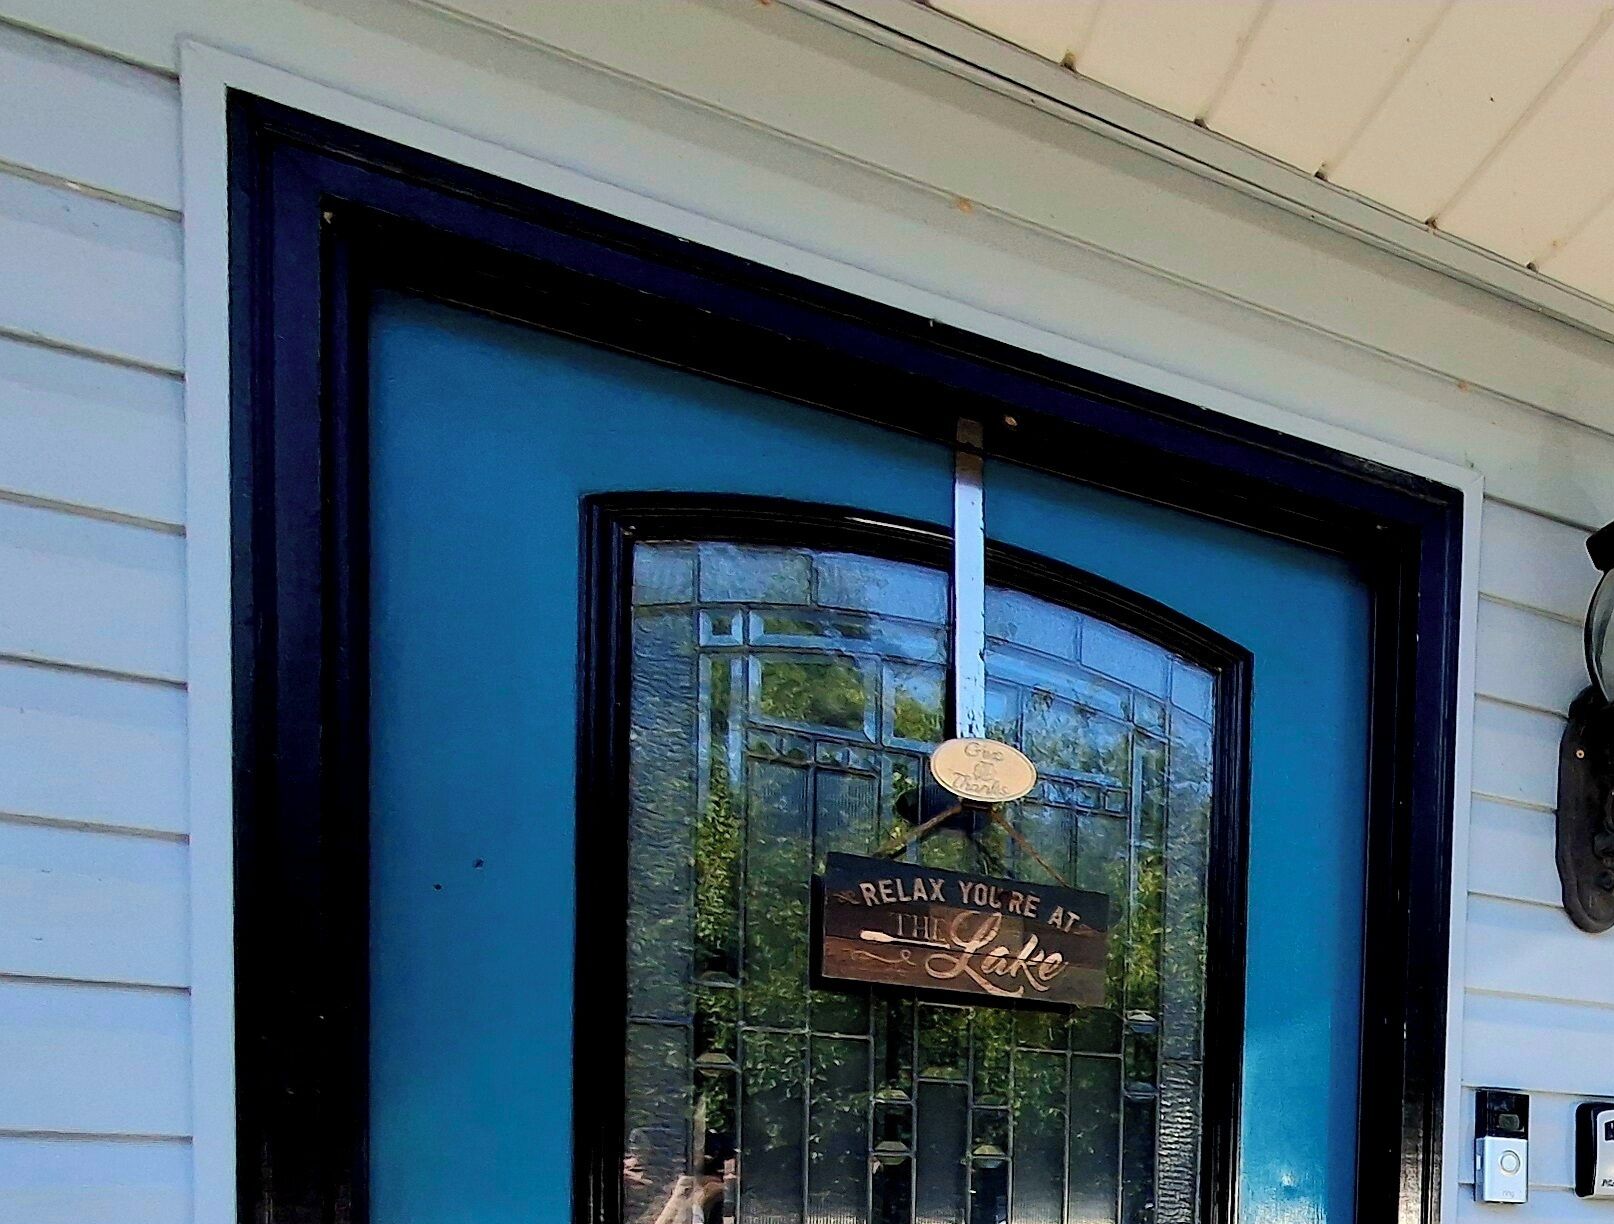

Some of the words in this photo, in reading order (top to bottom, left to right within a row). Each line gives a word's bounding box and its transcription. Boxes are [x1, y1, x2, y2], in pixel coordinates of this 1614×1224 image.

[859, 877, 946, 906] RELAX
[958, 880, 1041, 918] YOU'RE
[1047, 904, 1081, 933] AT
[889, 912, 949, 946] THE
[925, 910, 1069, 998] Lake
